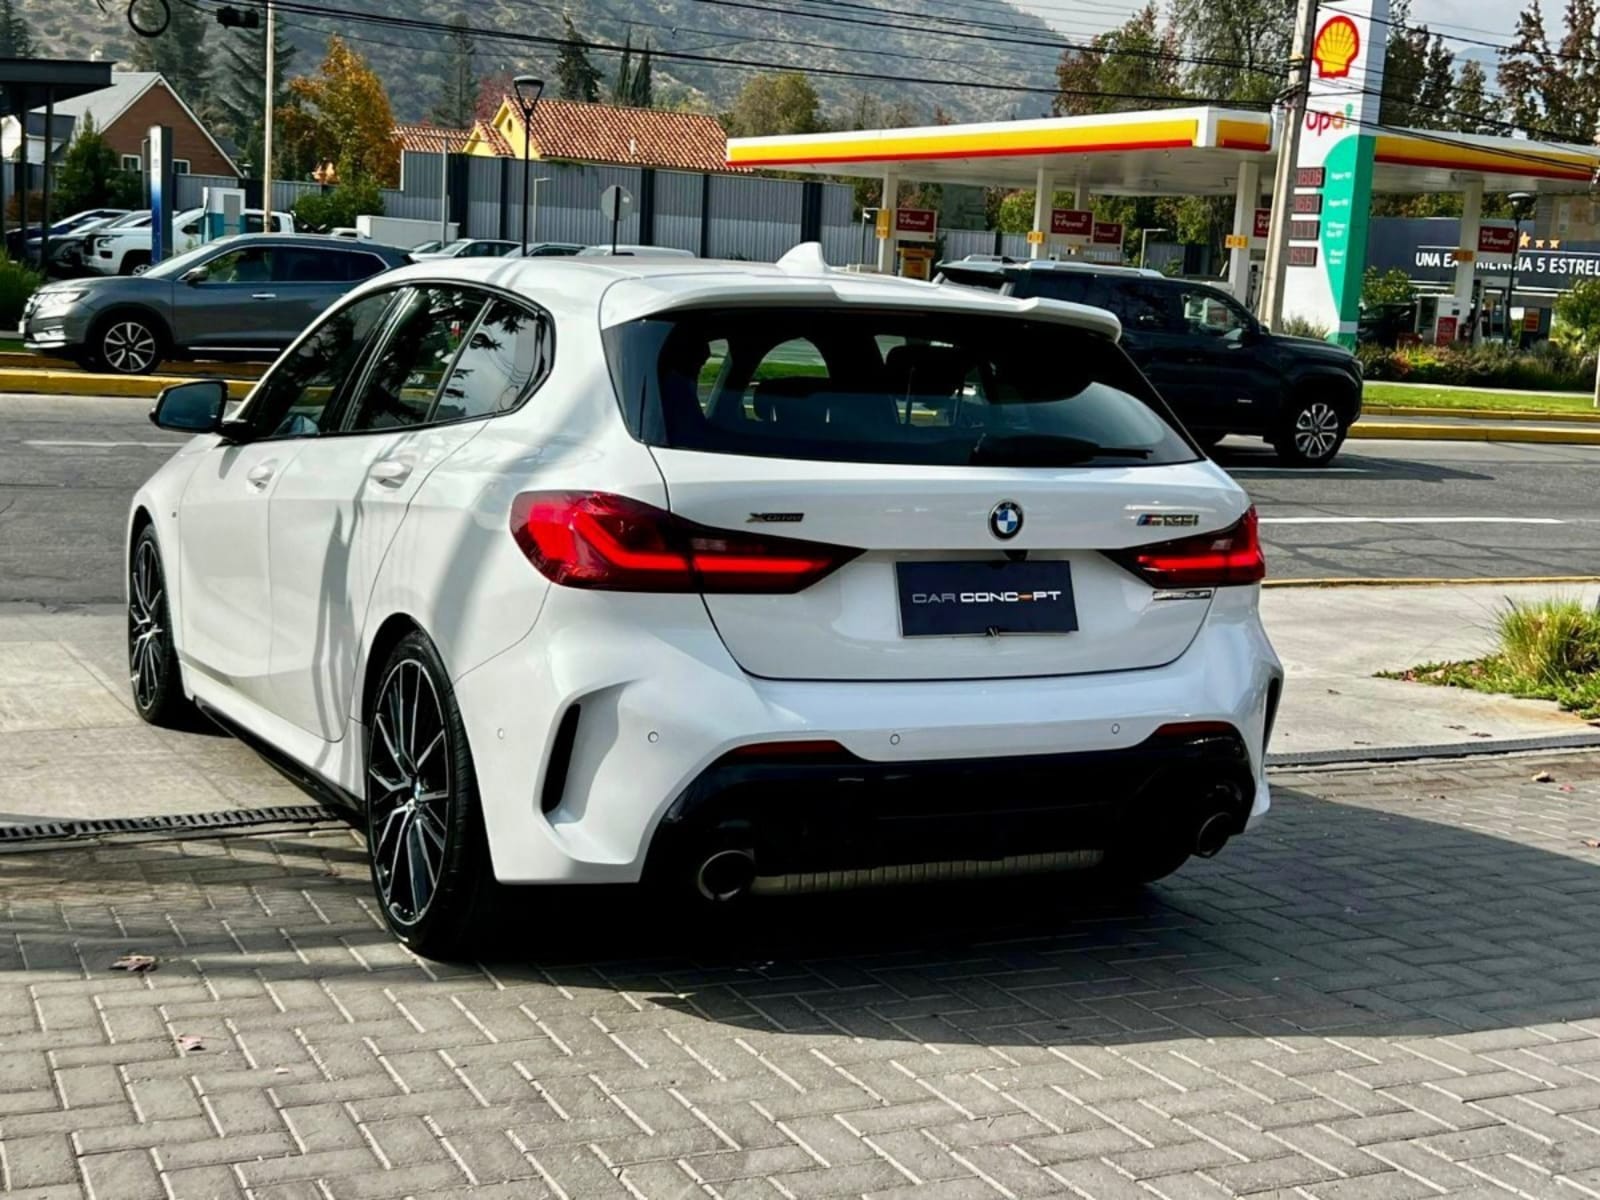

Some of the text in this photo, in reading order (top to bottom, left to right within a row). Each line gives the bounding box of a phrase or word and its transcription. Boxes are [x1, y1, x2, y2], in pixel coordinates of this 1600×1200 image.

[1415, 252, 1441, 267] UNA
[1536, 257, 1546, 273] 5
[1549, 257, 1600, 276] ESTREL
[912, 593, 956, 604] CAR
